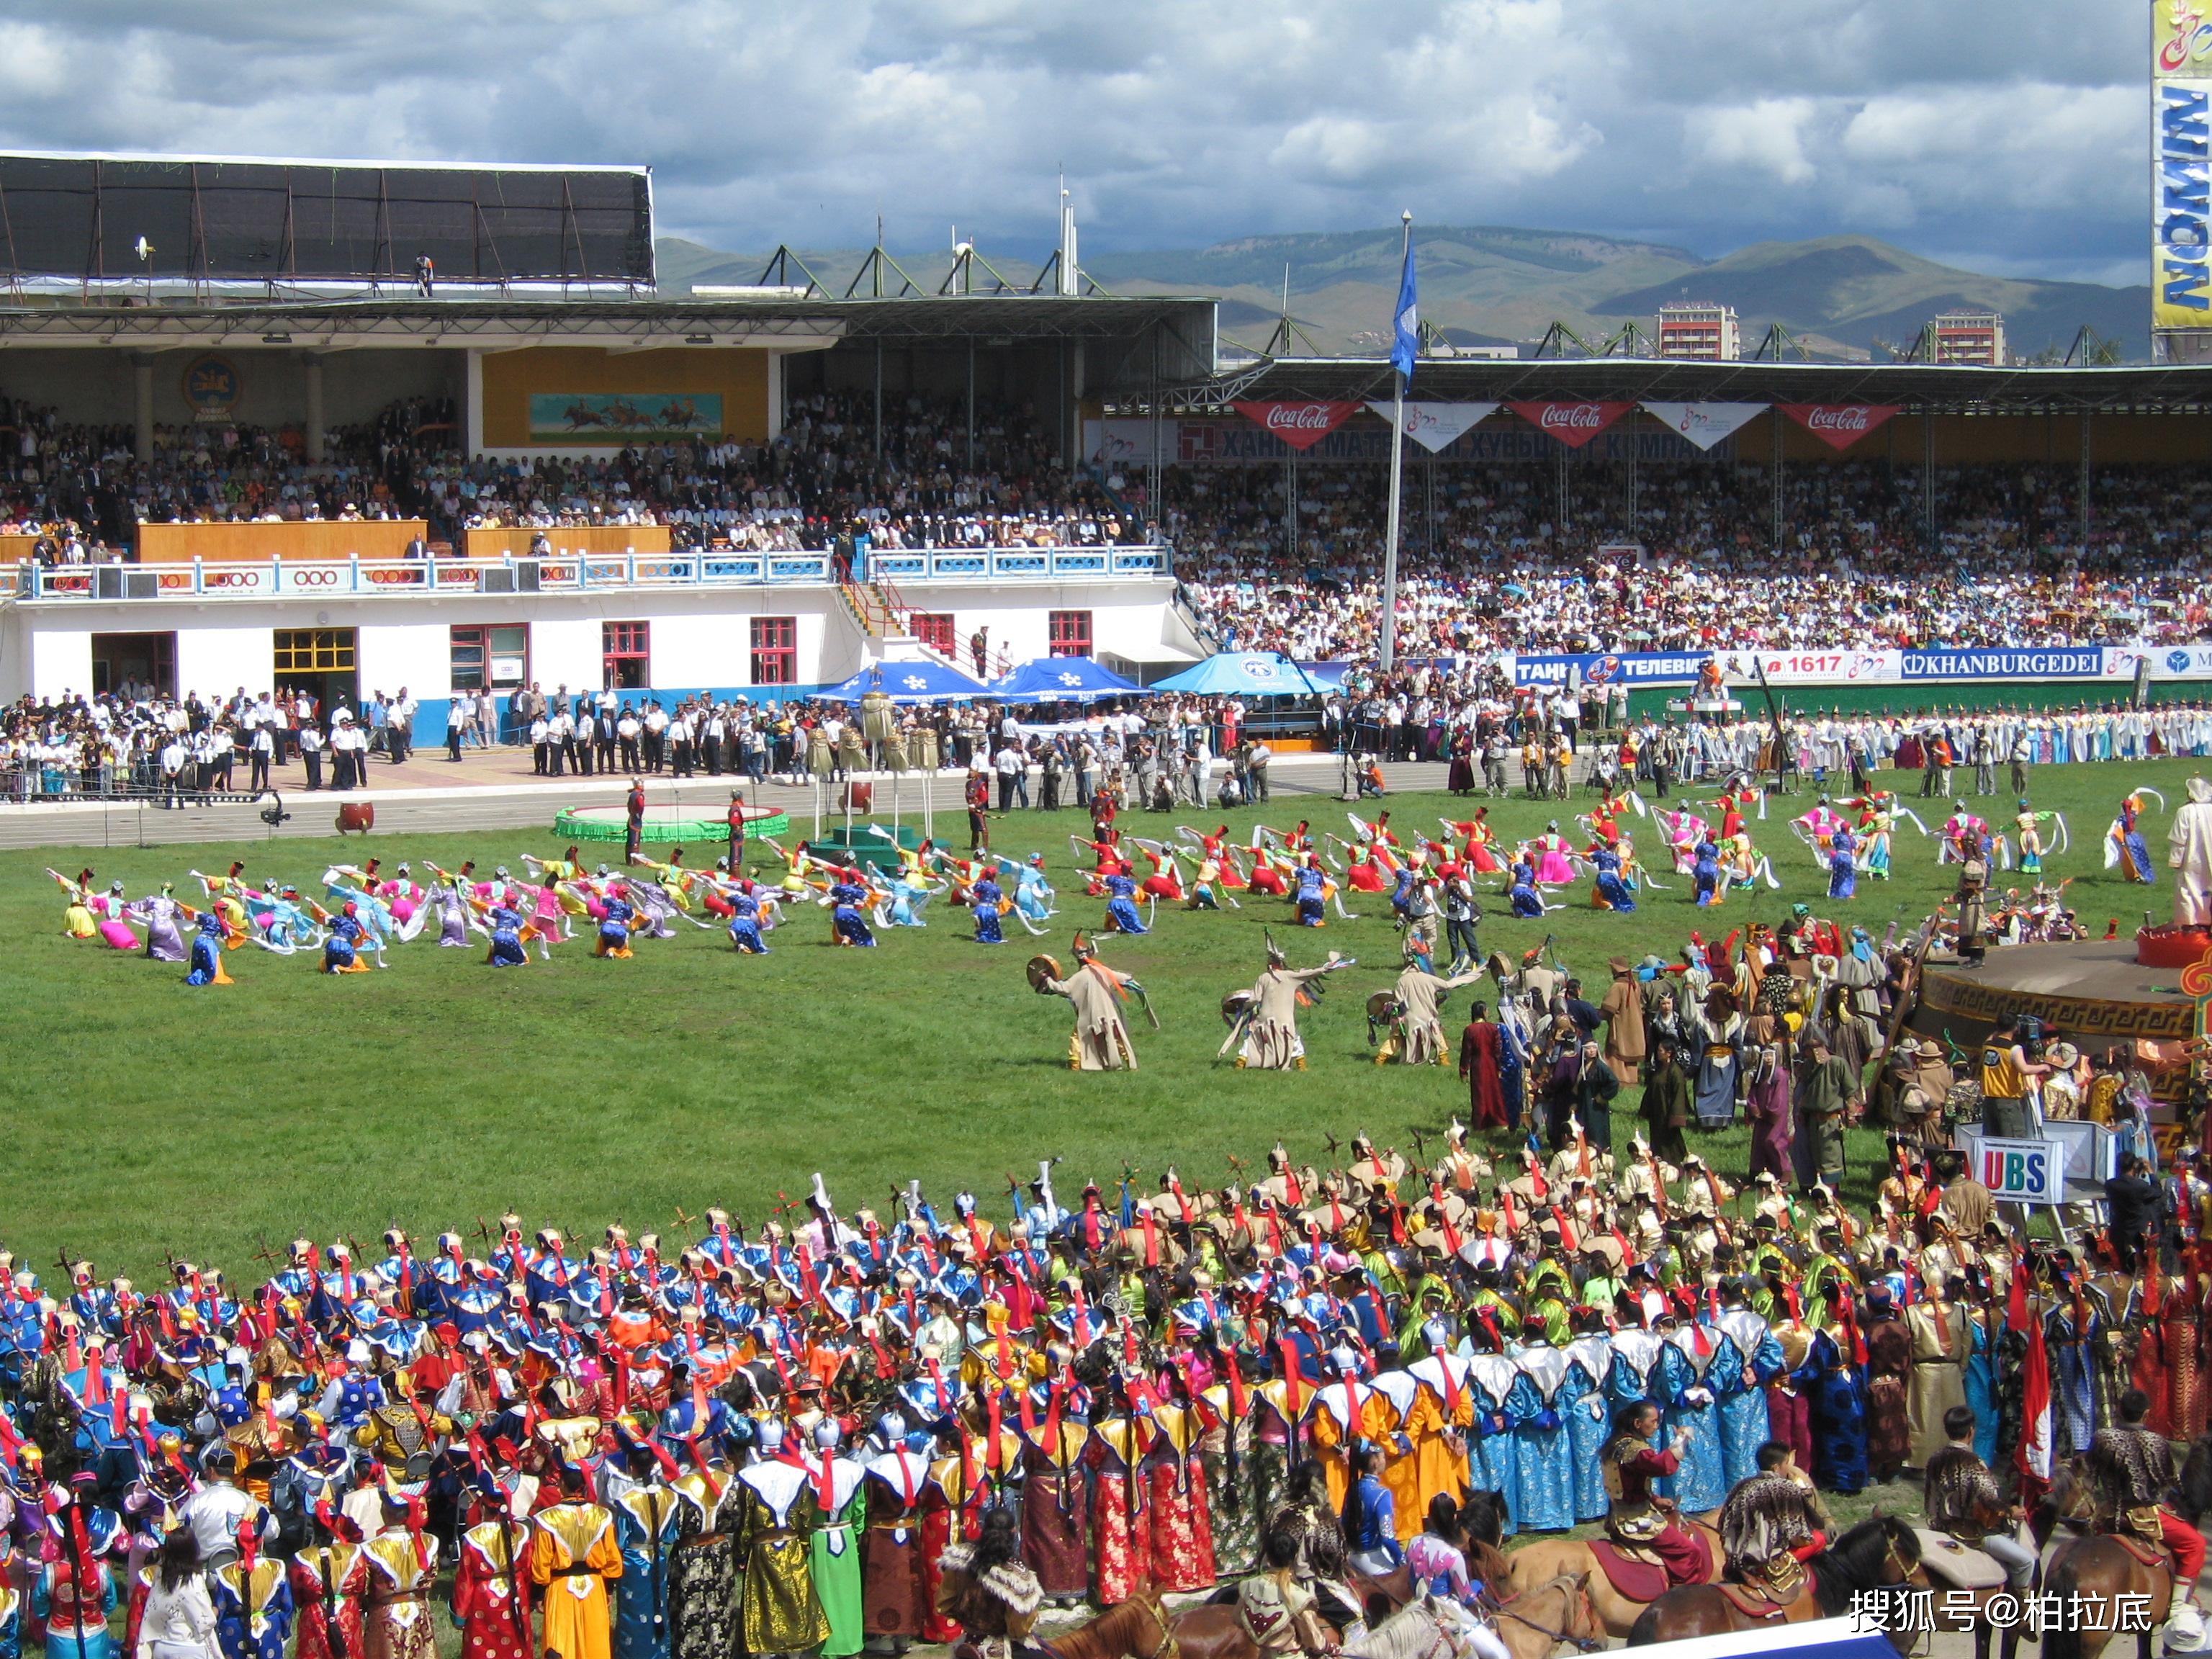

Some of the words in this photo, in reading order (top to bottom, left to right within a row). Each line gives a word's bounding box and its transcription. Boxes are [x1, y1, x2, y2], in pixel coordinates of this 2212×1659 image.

[2161, 86, 2210, 310] NOMIN
[1267, 405, 1330, 428] Coca-Cola
[1541, 403, 1601, 428] Coca-Cola
[1808, 407, 1868, 430] Coca-Cola
[1788, 656, 1842, 673] 1617
[1926, 654, 2099, 674] KHANBURGEDEI
[1984, 1151, 2045, 1193] UBS
